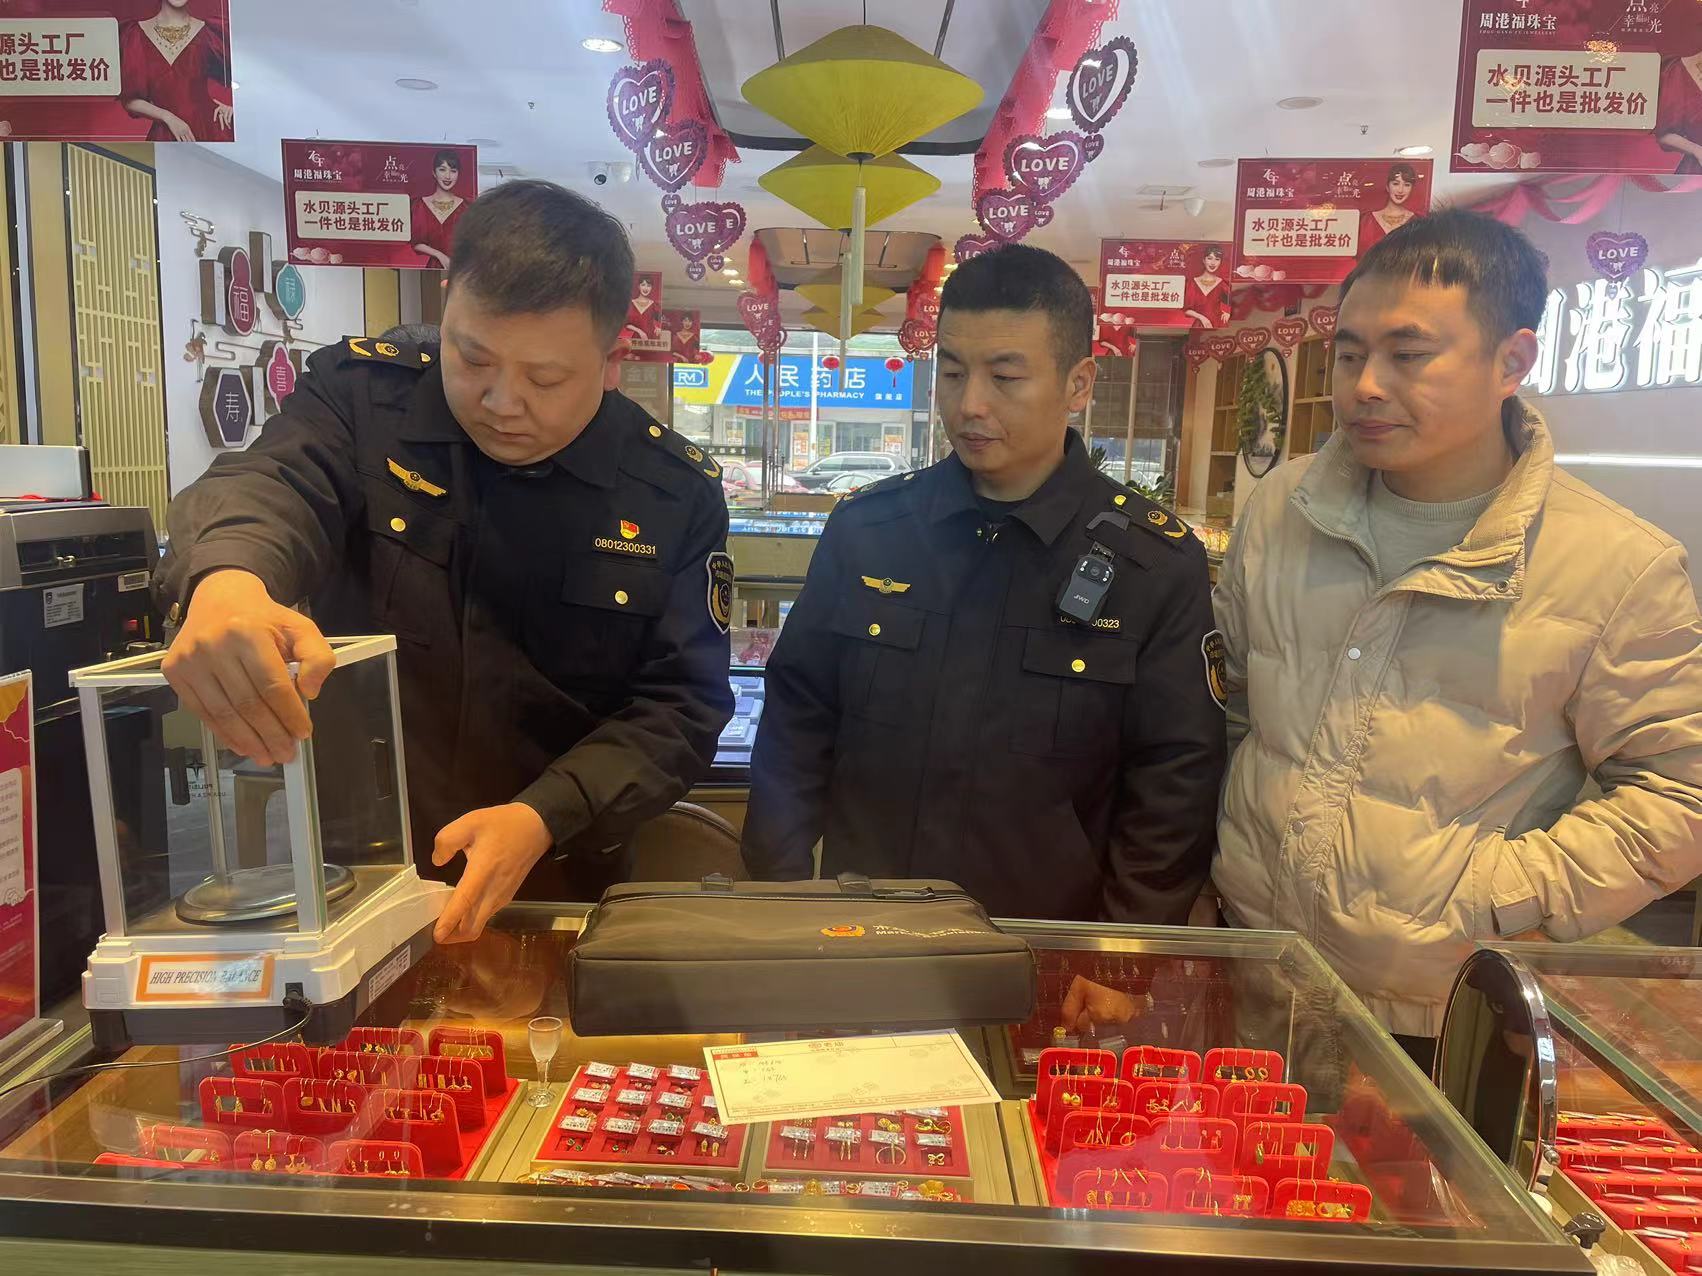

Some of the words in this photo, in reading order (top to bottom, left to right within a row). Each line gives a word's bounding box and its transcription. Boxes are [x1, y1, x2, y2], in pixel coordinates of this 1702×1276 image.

[1479, 12, 1558, 31] 周港福珠宝
[0, 58, 110, 81] 也是批发价
[1487, 63, 1627, 89] 水贝源头工厂
[1081, 63, 1114, 99] LOVE
[622, 86, 657, 116] LOVE
[1486, 91, 1648, 116] 一件也是批发价
[654, 141, 693, 163] LOVE
[1020, 157, 1070, 173] LOVE
[294, 168, 342, 181] 周港福珠宝
[303, 199, 389, 216] 水贝源头工厂
[988, 205, 1029, 219] LOVE
[304, 216, 405, 233] 一件也是批发价
[675, 221, 716, 236] LOVE
[1252, 217, 1338, 232] 水贝源头工厂
[1251, 233, 1351, 248] 一件也是批发价
[1598, 246, 1639, 260] LOVE
[1111, 280, 1171, 291] 水贝源头工厂
[1110, 291, 1180, 302] 一件也是批发价
[746, 303, 769, 312] LOVE
[1317, 315, 1336, 324] LOV
[1277, 326, 1301, 335] LOVE
[1211, 342, 1231, 350] LOVE
[1243, 335, 1264, 343] LOVE
[744, 364, 866, 390] 人民药店
[744, 388, 762, 396] THE
[225, 391, 240, 423] 寿
[594, 537, 656, 555] 08012300331
[150, 971, 174, 985] HIGH
[173, 970, 217, 984] PRECISION
